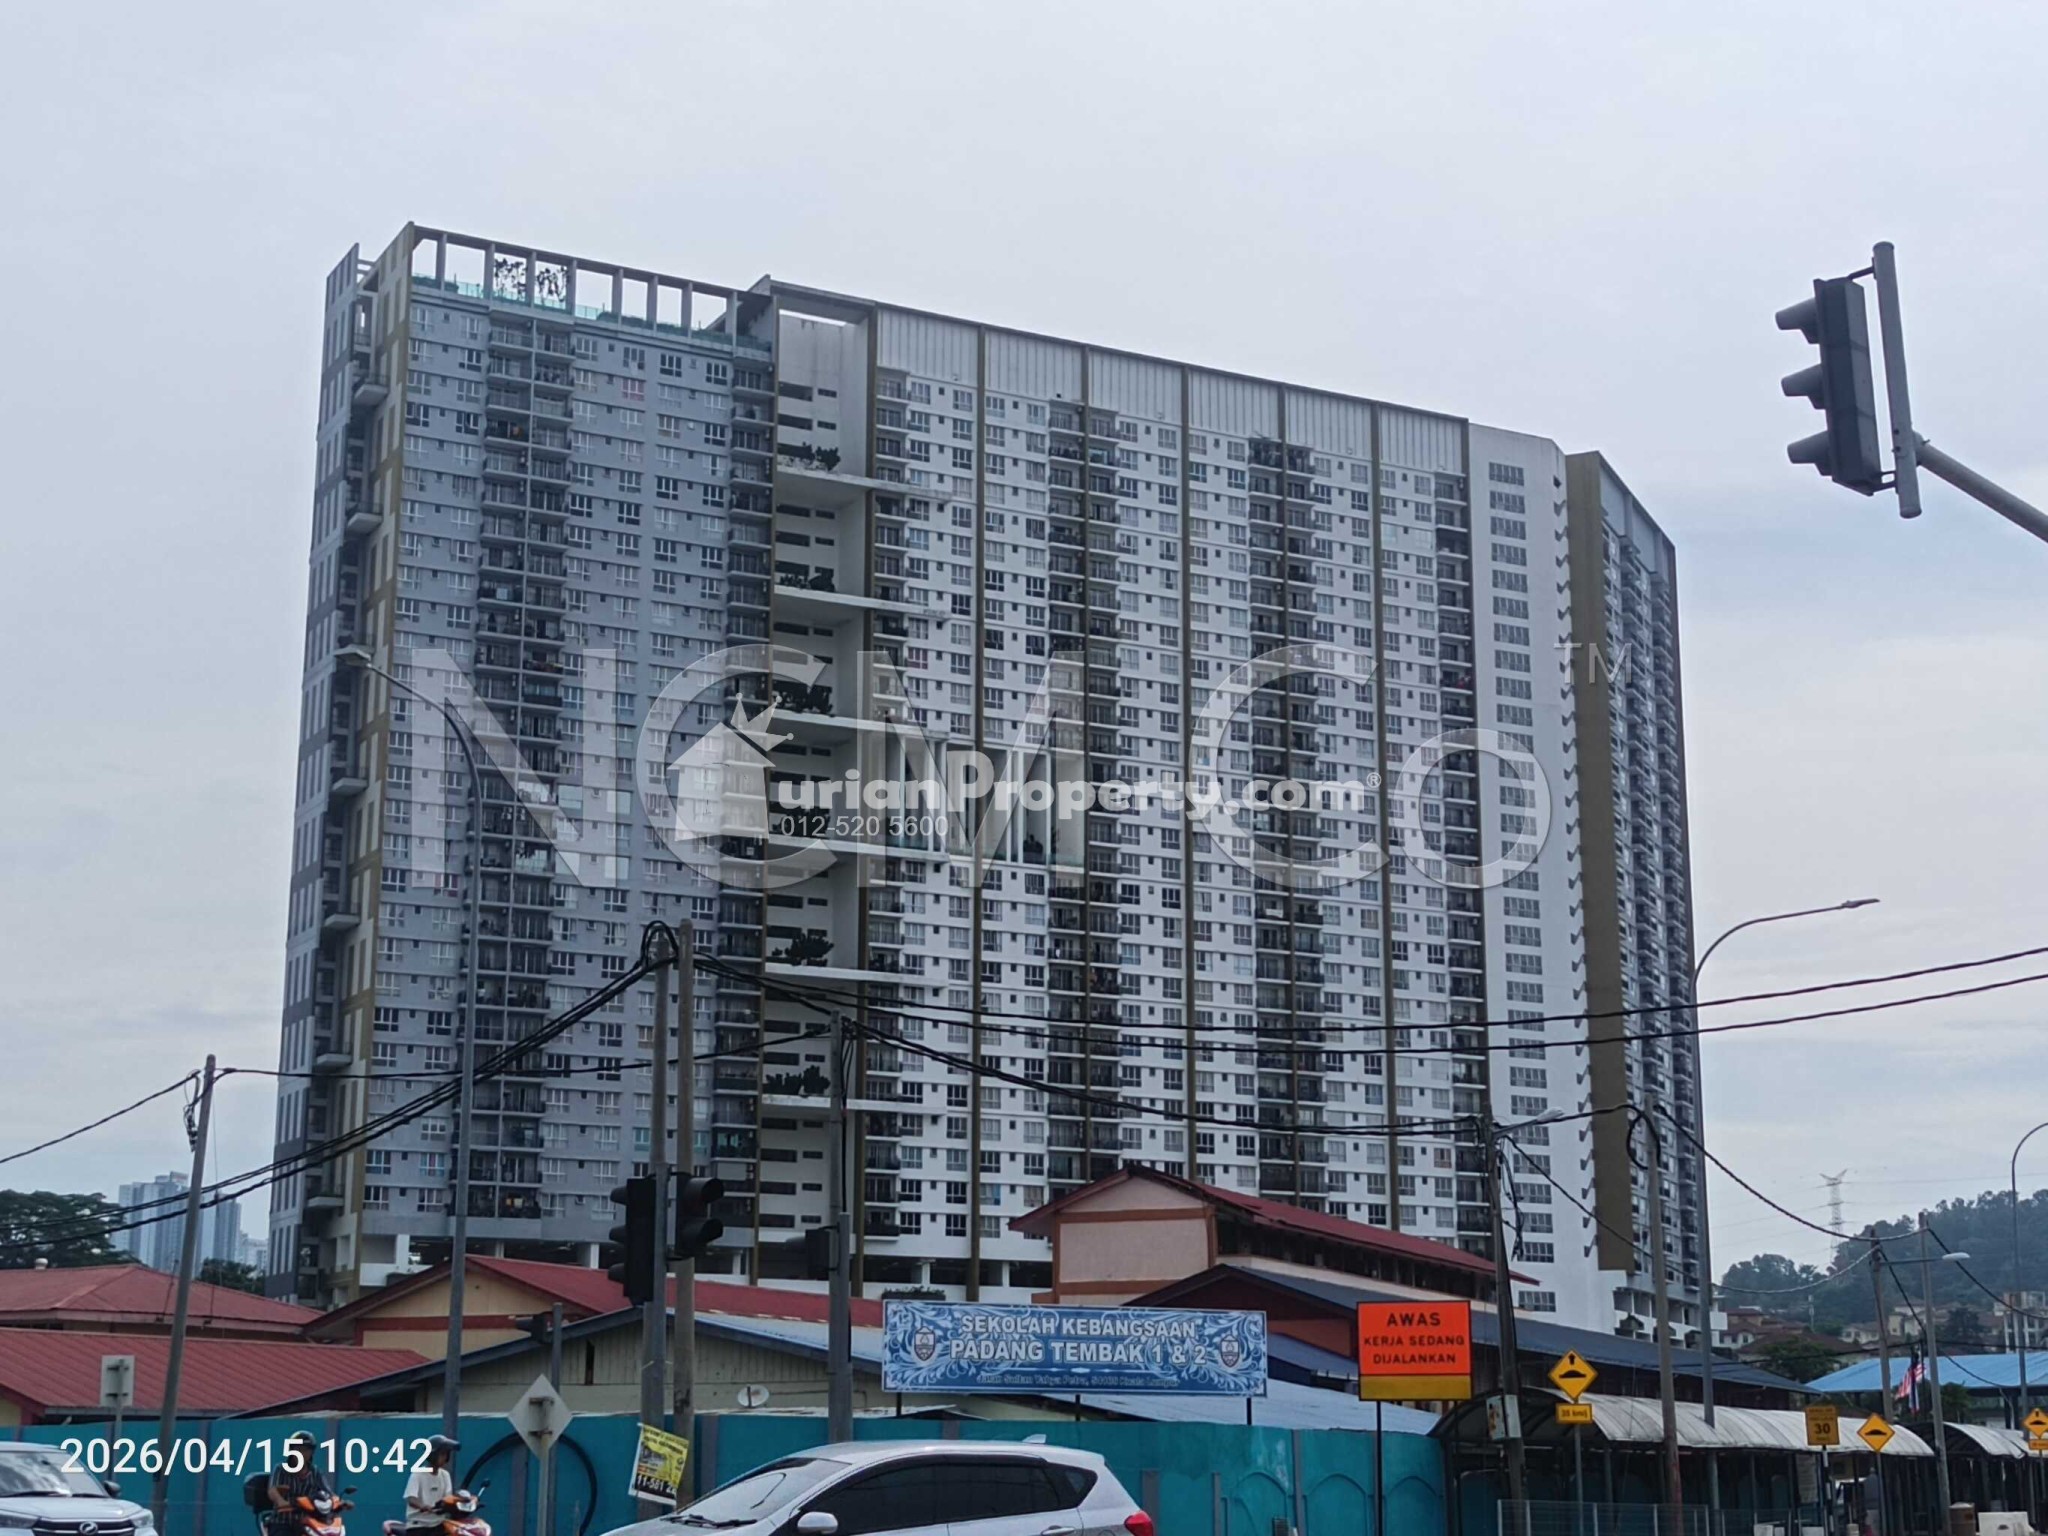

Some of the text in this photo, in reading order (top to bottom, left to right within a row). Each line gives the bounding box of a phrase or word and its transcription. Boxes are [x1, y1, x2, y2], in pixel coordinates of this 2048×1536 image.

[1387, 1312, 1441, 1326] AWAS
[960, 1315, 1197, 1338] SEKOLAH KEBANGSAAN
[1364, 1335, 1464, 1346] KERJA SEDANG
[950, 1339, 1207, 1364] PADANG TEMBAK 1 & 2
[1373, 1353, 1456, 1365] DIJALANKAN
[1815, 1423, 1830, 1435] 30
